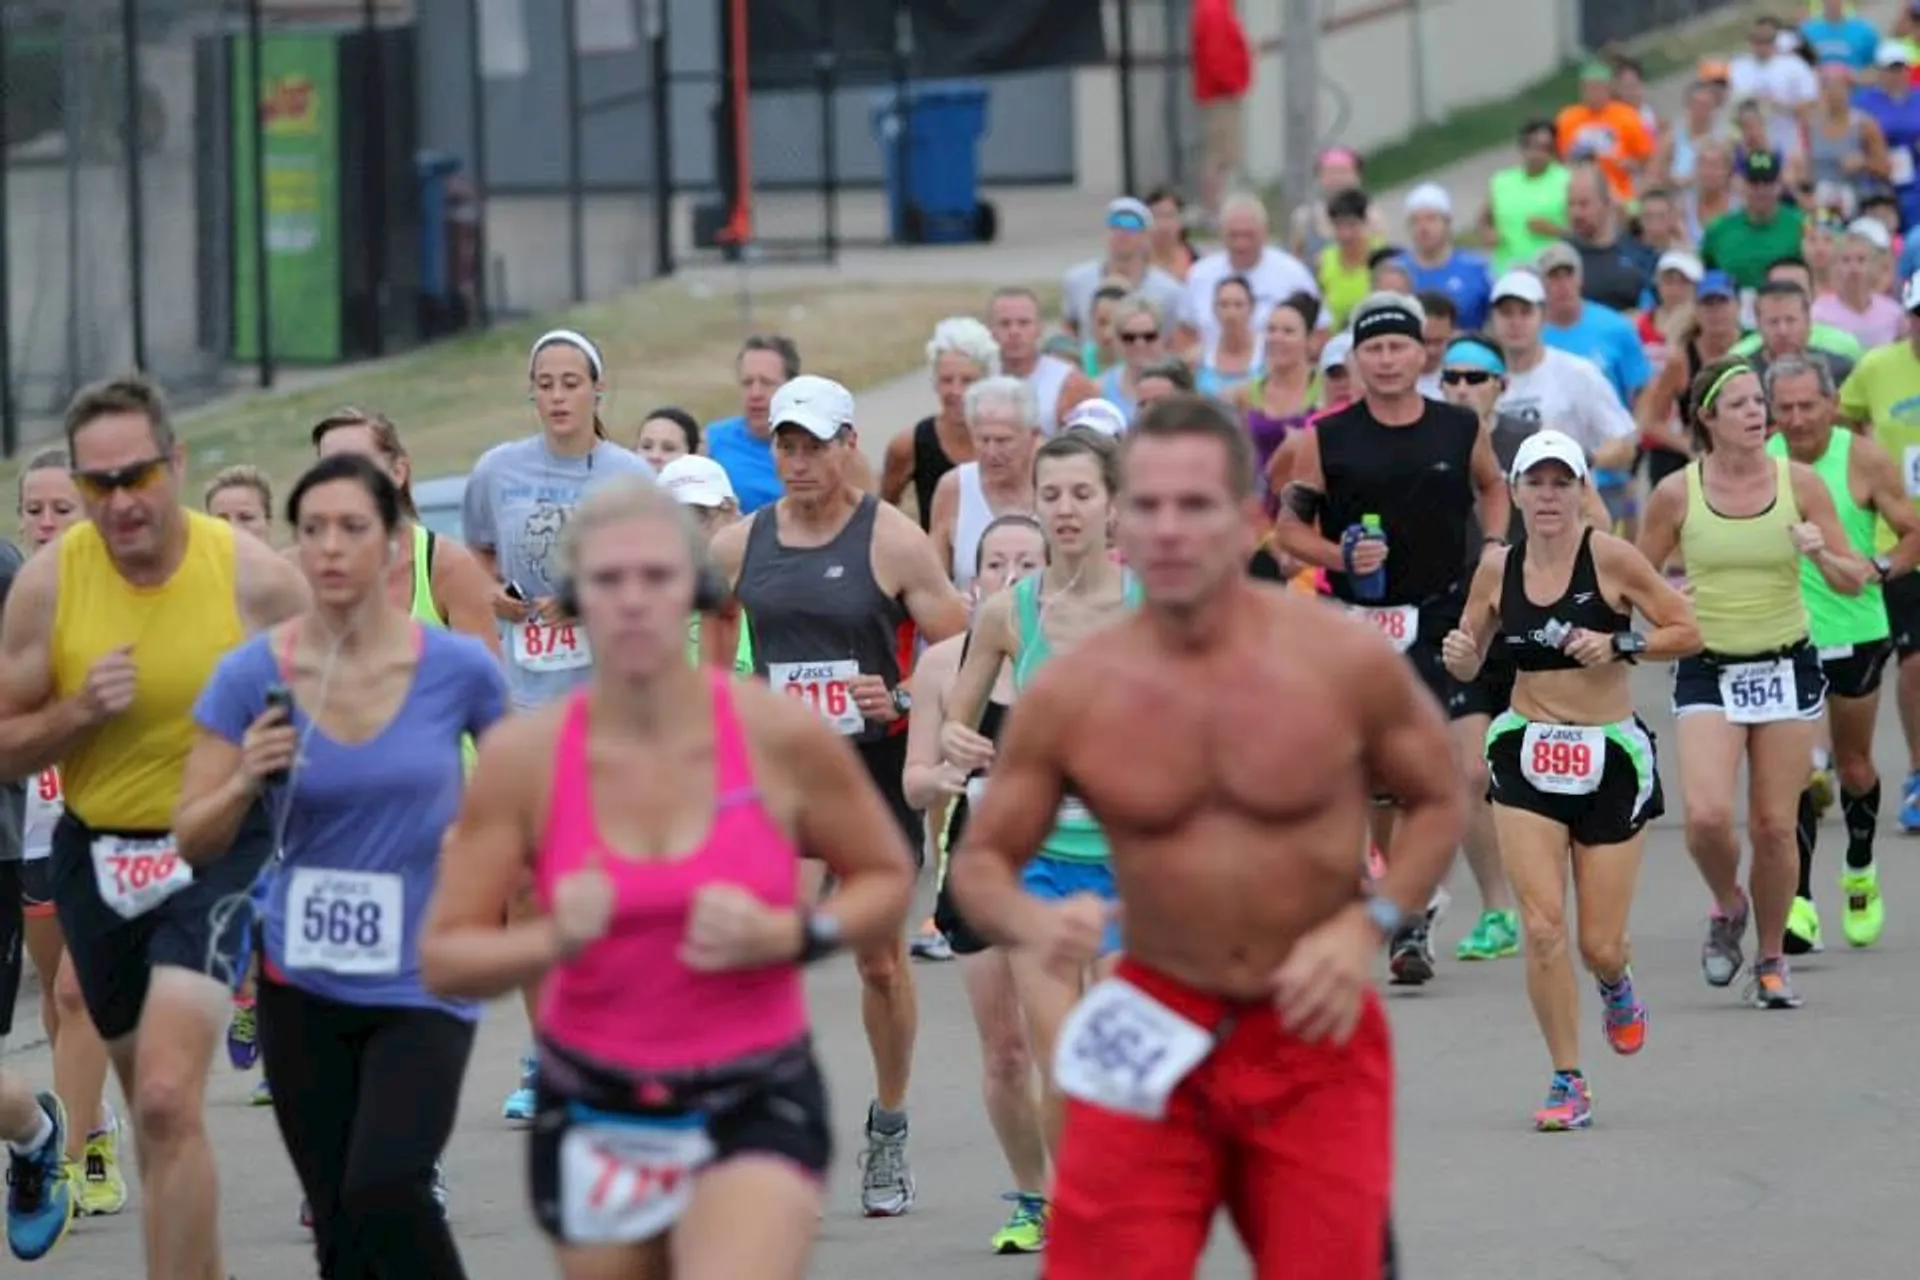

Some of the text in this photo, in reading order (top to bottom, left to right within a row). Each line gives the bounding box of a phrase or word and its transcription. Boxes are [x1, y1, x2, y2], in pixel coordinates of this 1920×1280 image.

[1731, 677, 1783, 708] 554
[1532, 740, 1590, 777] 899
[303, 896, 381, 948] 568
